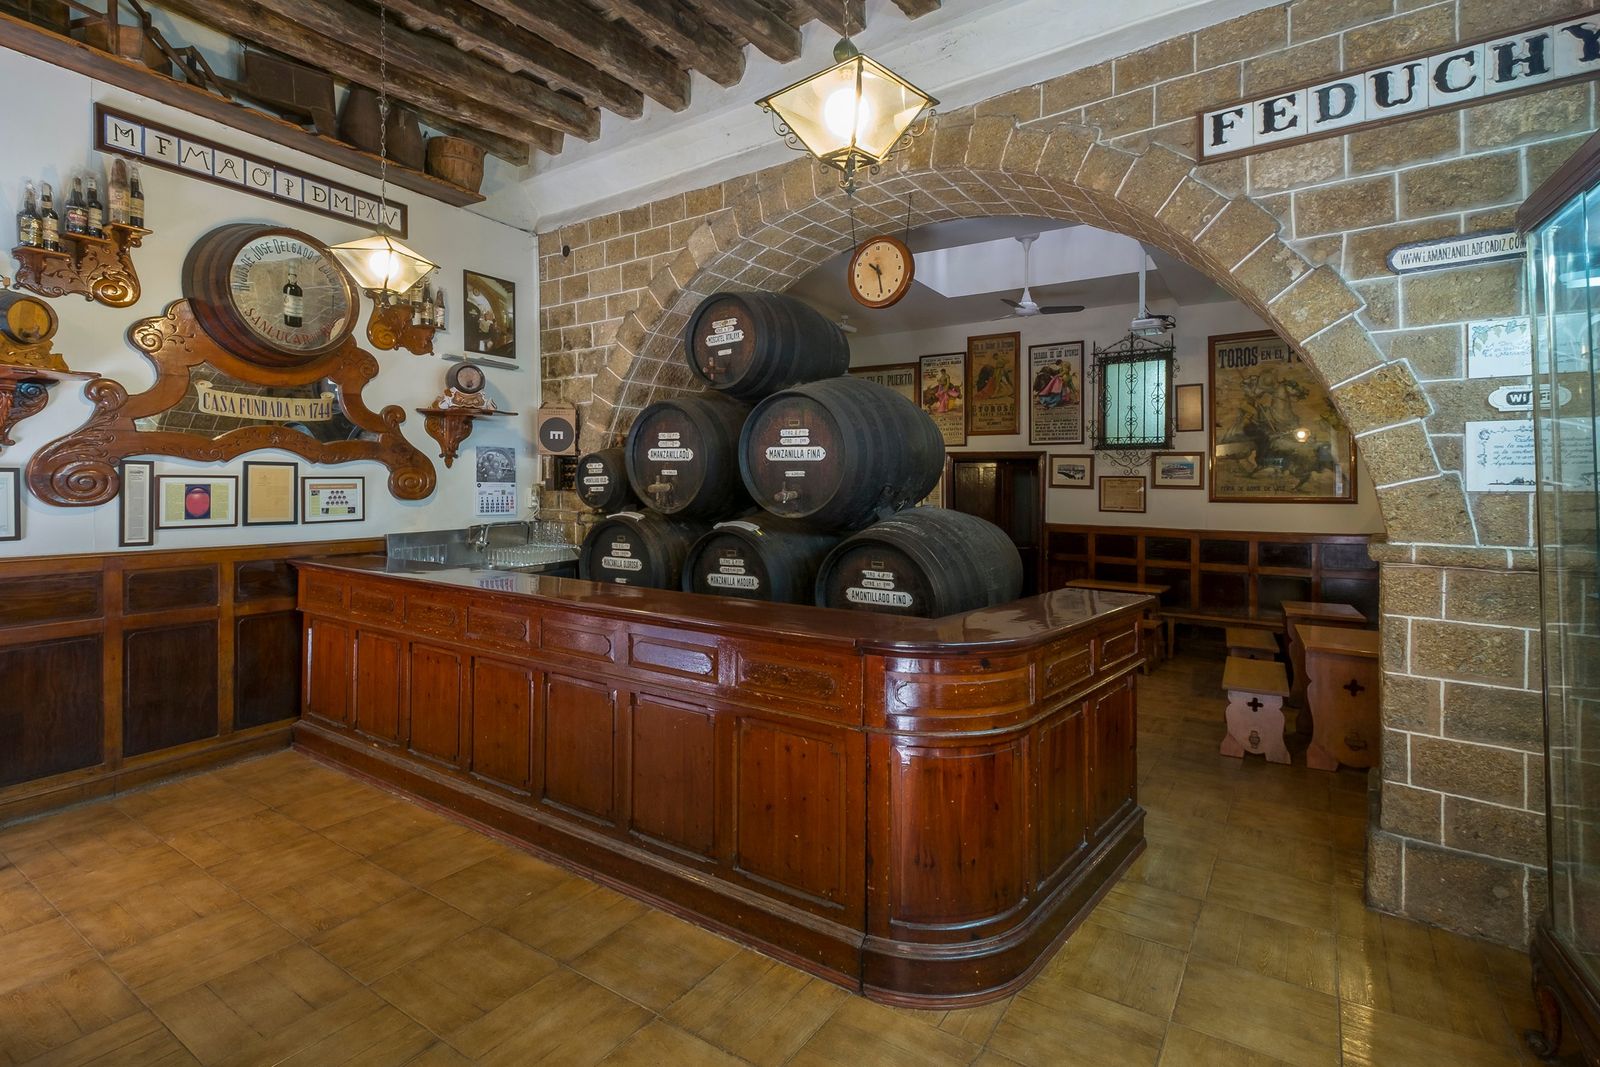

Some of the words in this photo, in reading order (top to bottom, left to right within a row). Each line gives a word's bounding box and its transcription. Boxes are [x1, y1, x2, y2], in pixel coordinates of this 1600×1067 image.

[1210, 22, 1600, 147] FEDUCHY
[113, 122, 136, 147] M
[155, 135, 172, 155] F
[181, 146, 210, 170] M
[218, 158, 239, 179] A
[251, 241, 274, 261] JOSE
[272, 238, 314, 260] DELGADO
[1219, 346, 1258, 368] TOROS
[1261, 349, 1272, 360] EN
[1274, 348, 1284, 360] EL
[203, 392, 236, 414] CASA
[240, 398, 291, 418] FUNDADA
[294, 404, 306, 416] EN
[309, 402, 330, 419] 1744
[769, 449, 804, 459] MANZANILLA
[806, 448, 821, 459] FINA
[710, 575, 735, 586] MANZANILLA
[851, 590, 890, 603] AMONTILLADO
[892, 594, 907, 605] FINO
